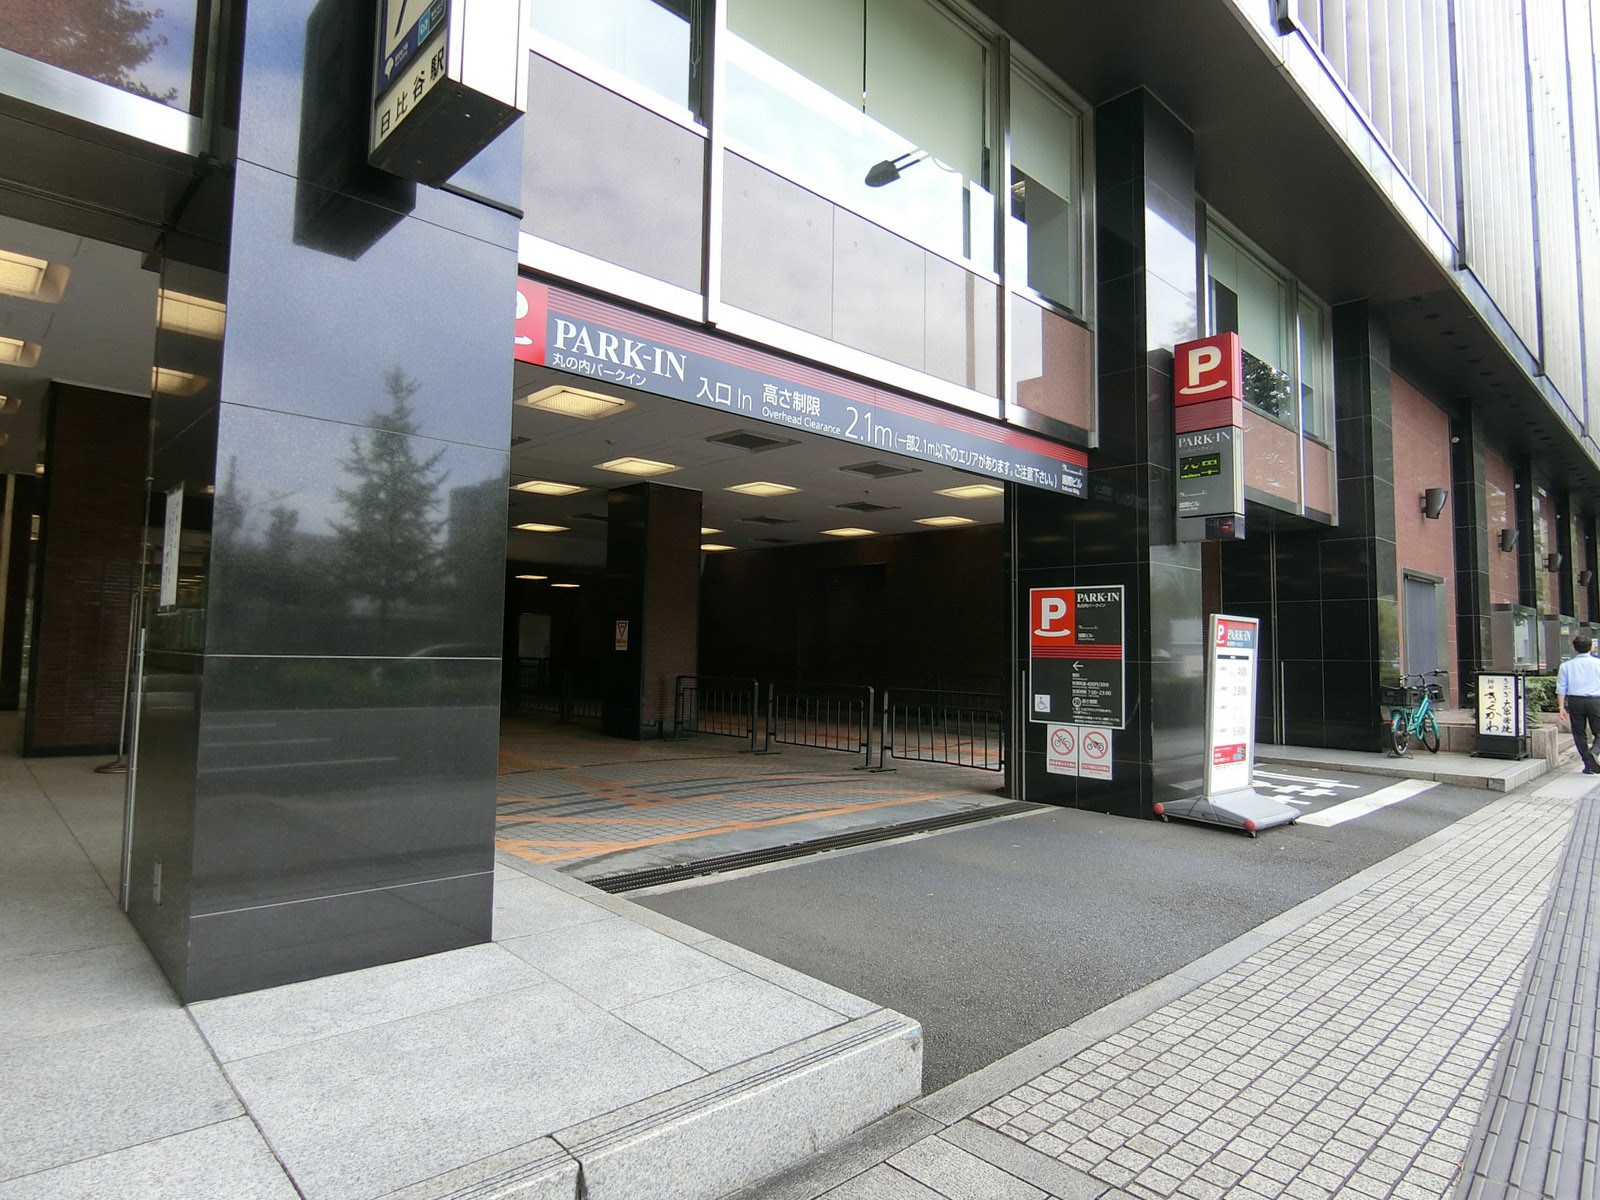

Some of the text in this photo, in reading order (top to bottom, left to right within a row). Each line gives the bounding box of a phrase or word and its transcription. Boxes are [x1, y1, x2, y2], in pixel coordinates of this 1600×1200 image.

[380, 46, 445, 138] 日比谷駅
[553, 318, 688, 382] PARK-IN
[1188, 345, 1222, 387] P
[552, 351, 647, 387] 丸の内パークイン
[696, 376, 753, 411] 入口 In
[762, 382, 821, 418] 高さ制限
[761, 406, 842, 435] Overhead Clearance
[844, 405, 894, 448] 2.1m
[1178, 431, 1230, 448] PARK-IN
[1041, 592, 1119, 629] P PARK-IN
[1227, 627, 1251, 642] PARK-IN
